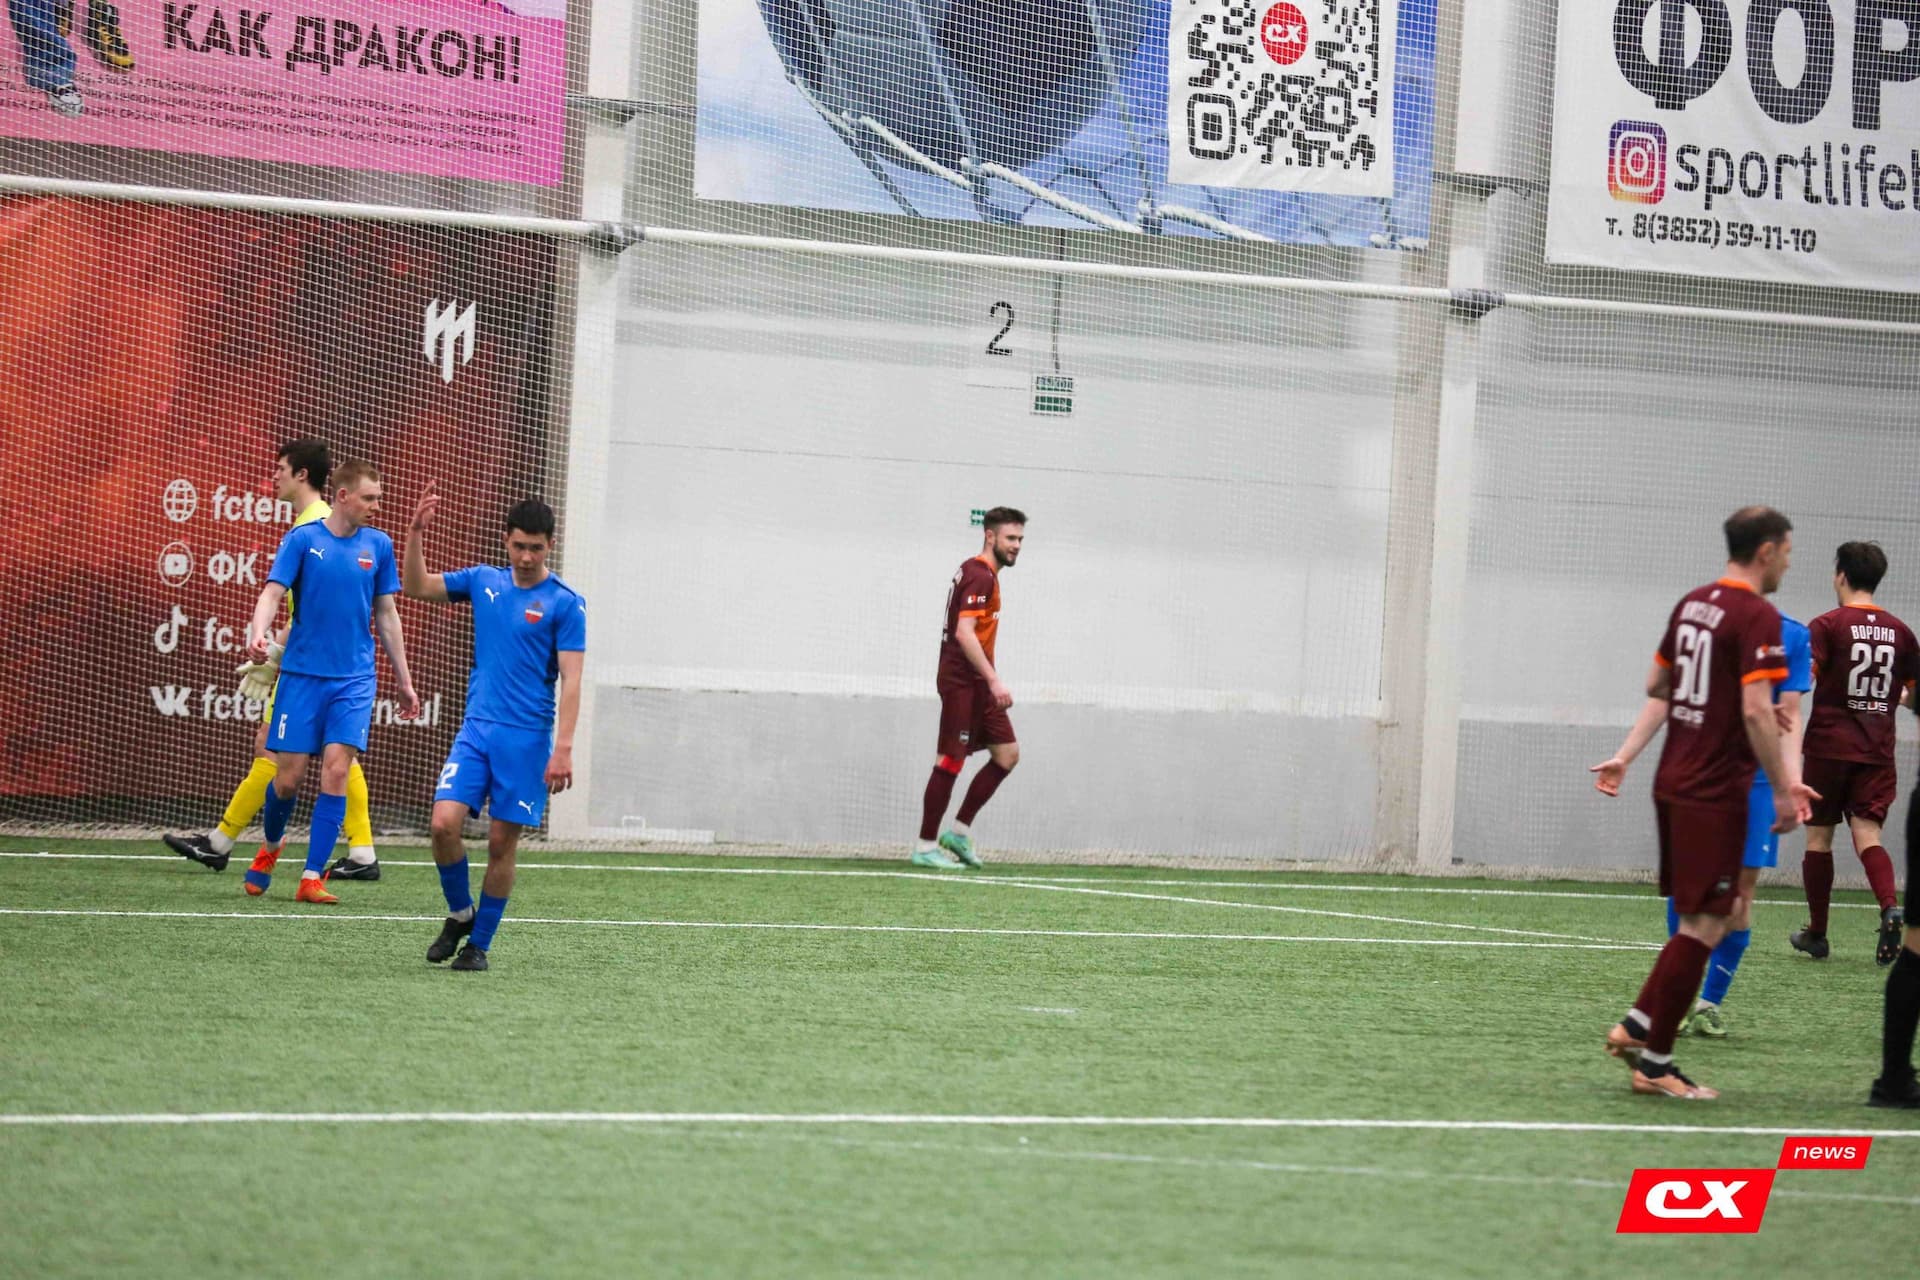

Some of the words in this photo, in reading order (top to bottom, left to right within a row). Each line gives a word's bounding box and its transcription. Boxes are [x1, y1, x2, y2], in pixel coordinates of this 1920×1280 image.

[163, 2, 272, 59] КАК
[286, 15, 521, 84] ДРАКОН!
[1632, 212, 1721, 249] 8(3852)
[1725, 221, 1817, 253] 59-11-10
[985, 301, 1015, 356] 2
[208, 550, 257, 586] ФК
[1850, 624, 1896, 643] ВОРОНА
[1847, 642, 1896, 699] 23
[1847, 699, 1889, 712] SEUS
[277, 713, 288, 740] 6
